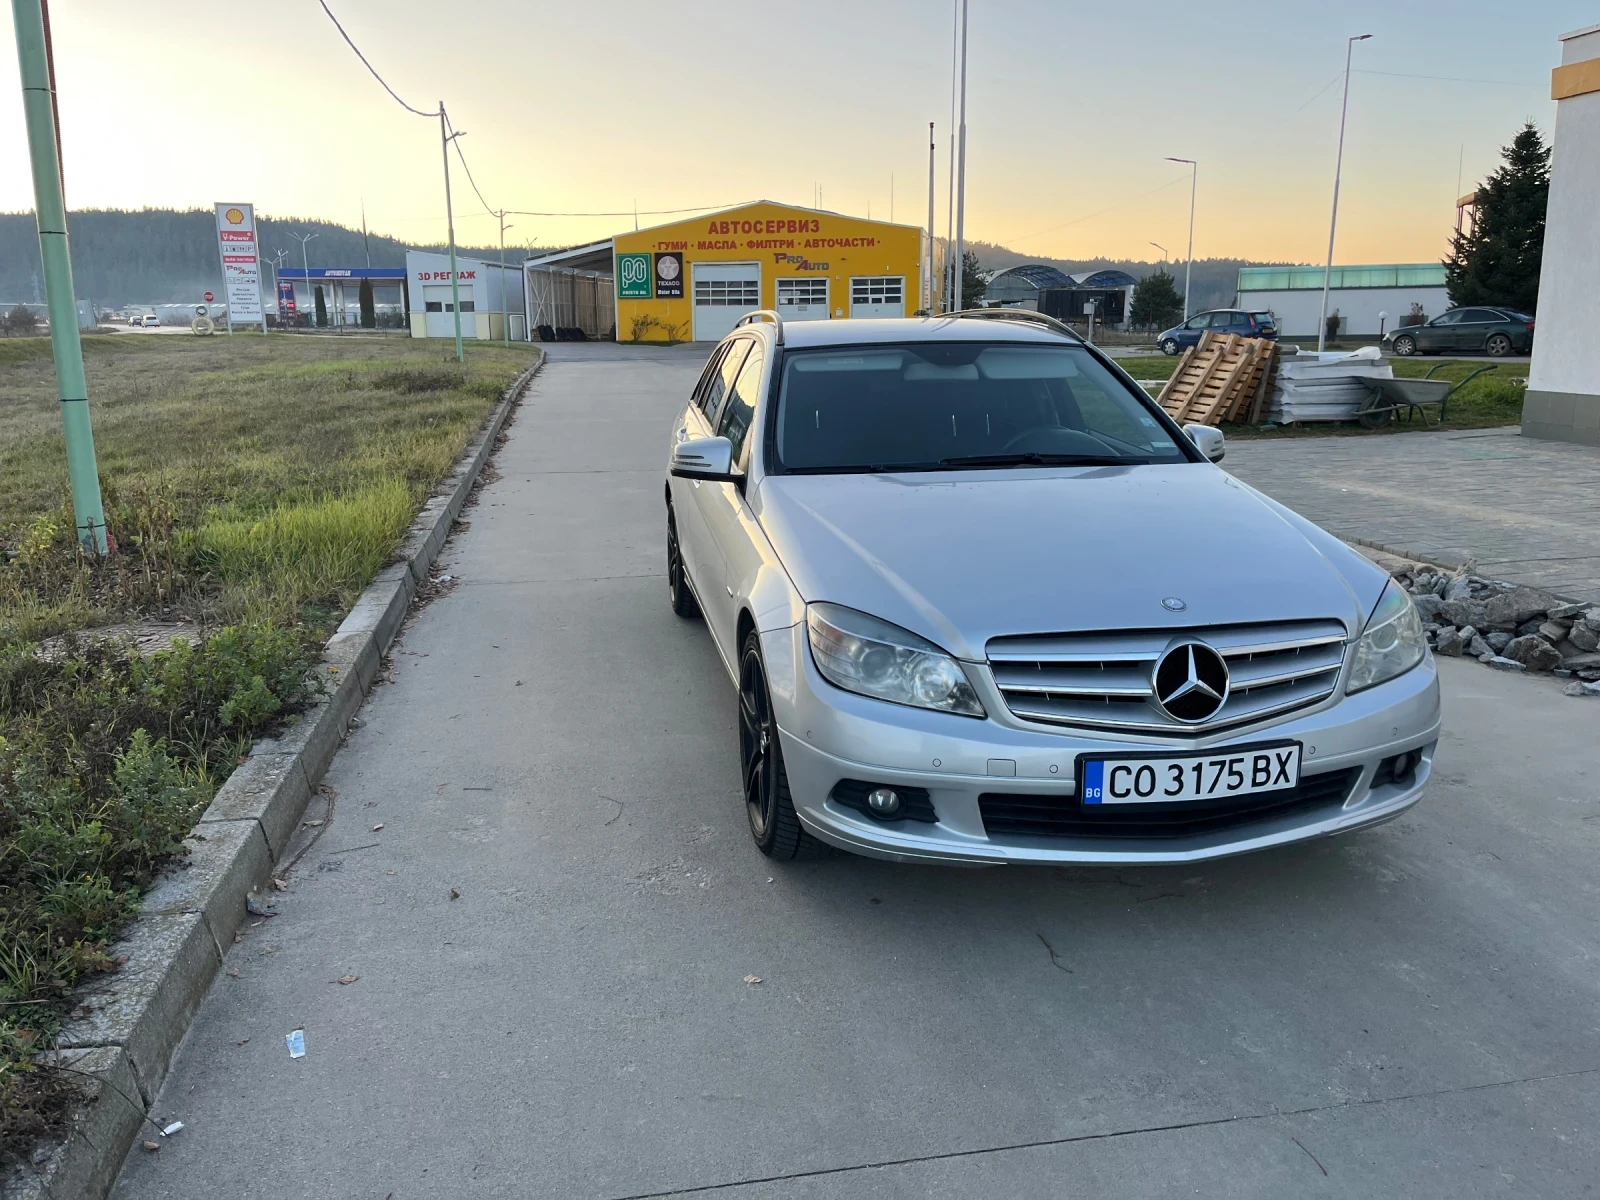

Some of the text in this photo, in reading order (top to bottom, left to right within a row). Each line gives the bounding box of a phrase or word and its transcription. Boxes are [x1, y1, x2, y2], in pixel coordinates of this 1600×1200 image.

[708, 219, 820, 235] АВТОСЕРВИЗ
[657, 237, 875, 251] ГУМИ МАСЛА ФИЛТРИ АВТОЧАСТИ
[418, 270, 476, 281] 3D РЕГАЖ
[1085, 751, 1294, 799] BG CO 3175 BX
